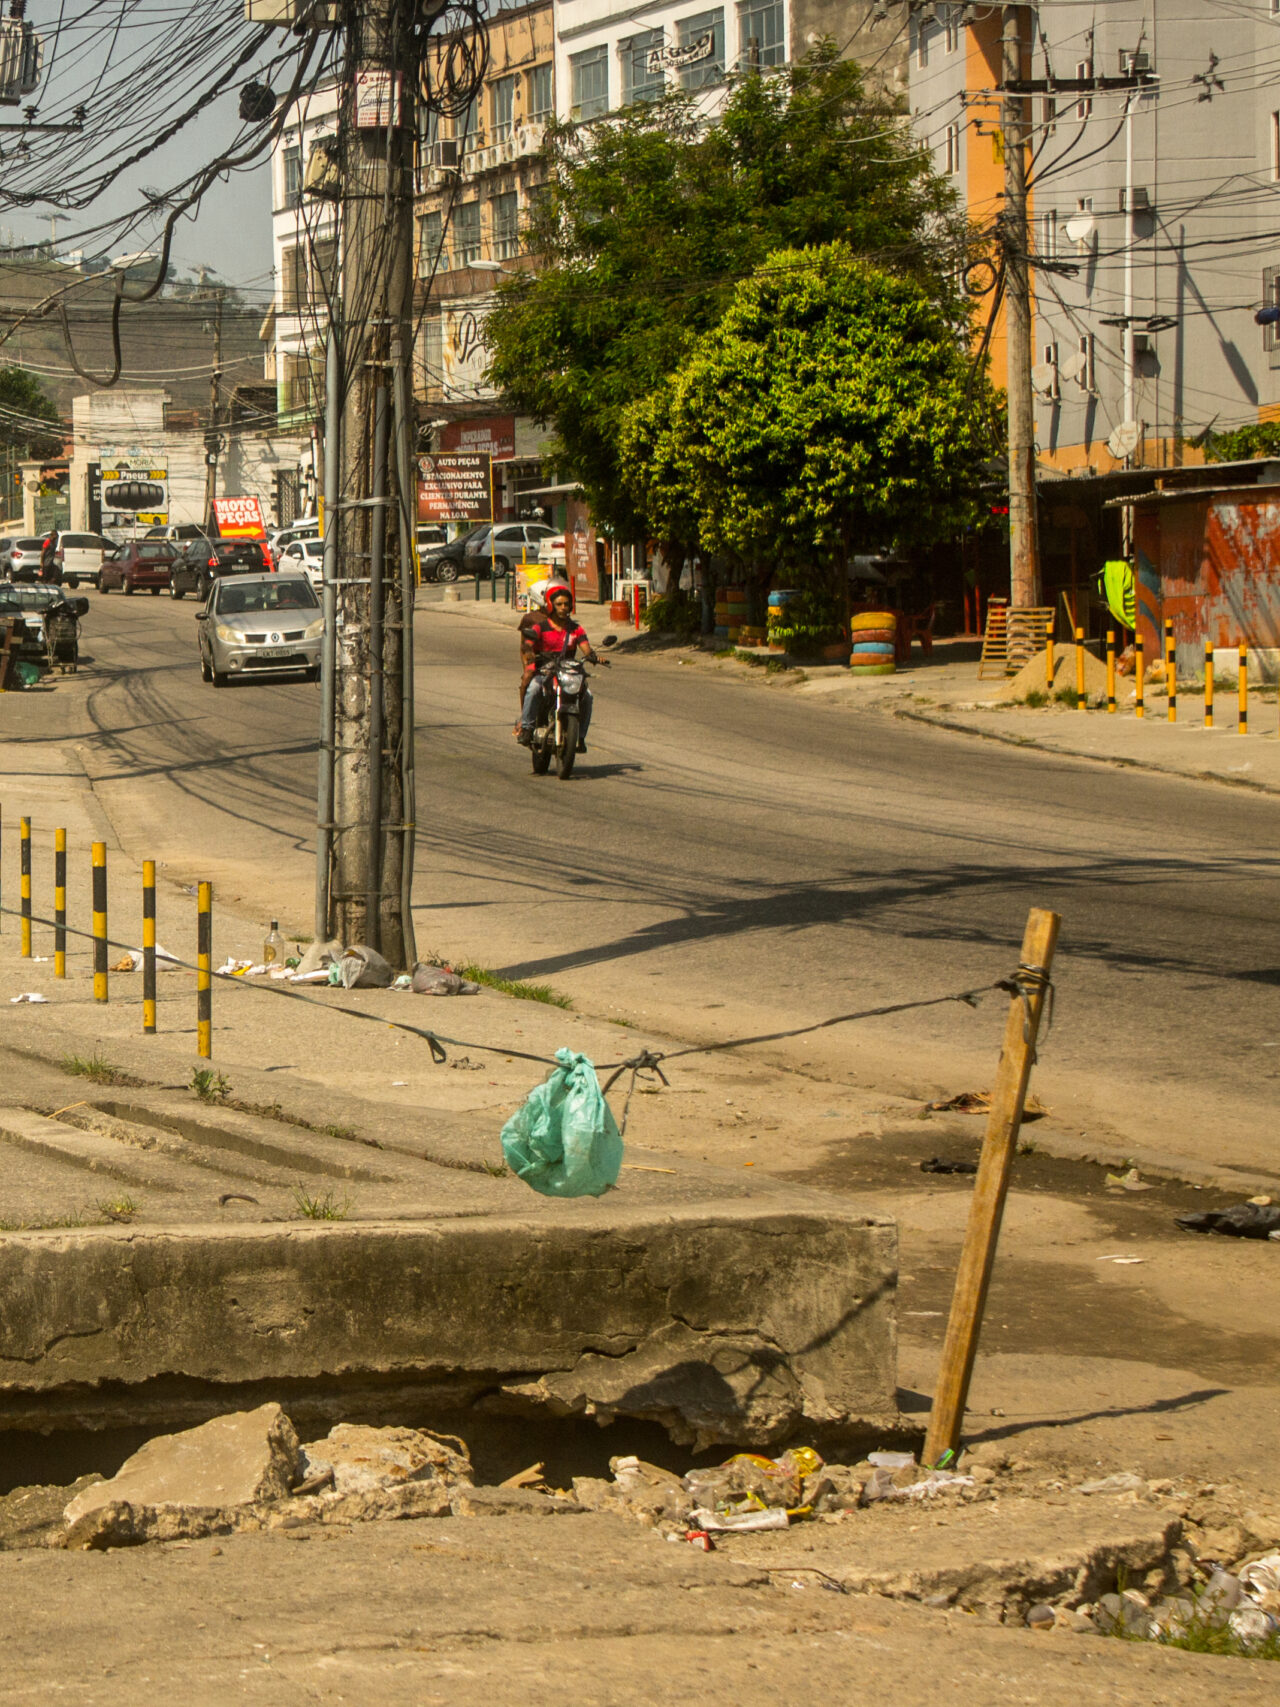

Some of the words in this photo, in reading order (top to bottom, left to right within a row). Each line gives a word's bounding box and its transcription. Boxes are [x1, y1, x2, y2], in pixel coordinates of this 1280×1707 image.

[650, 34, 710, 64] ALUGO
[437, 458, 457, 466] AUTO
[457, 457, 480, 467] PEÇAS
[120, 471, 148, 480] Pneus
[422, 471, 485, 480] ESTACIONAMENTO
[424, 482, 463, 490] EXCLUSIVO
[463, 481, 483, 490] PARA
[420, 492, 453, 501] CLIENTES
[454, 491, 488, 499] DURANTE
[216, 499, 256, 512] MOTO
[217, 511, 260, 526] PEÇAS
[440, 511, 450, 519] NA
[451, 511, 469, 519] LOJA
